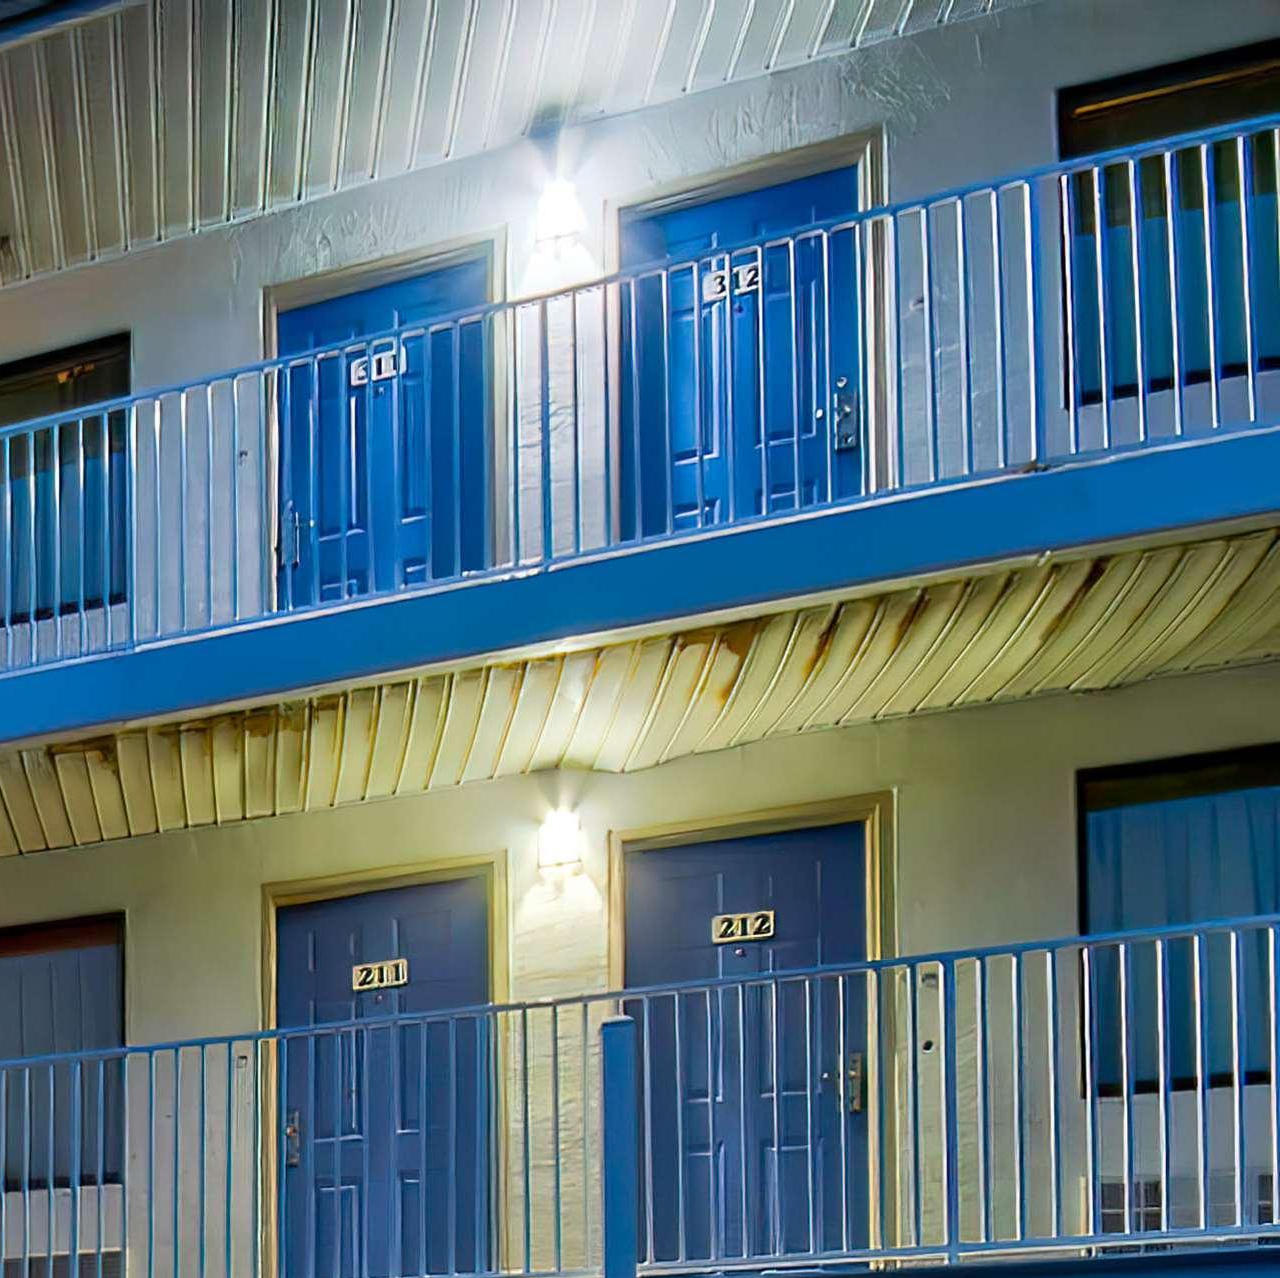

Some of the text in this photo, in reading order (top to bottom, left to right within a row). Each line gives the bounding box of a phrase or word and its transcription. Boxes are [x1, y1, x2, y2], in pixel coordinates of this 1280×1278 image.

[713, 266, 760, 295] 312
[719, 913, 772, 938] 212
[357, 962, 404, 987] 211
